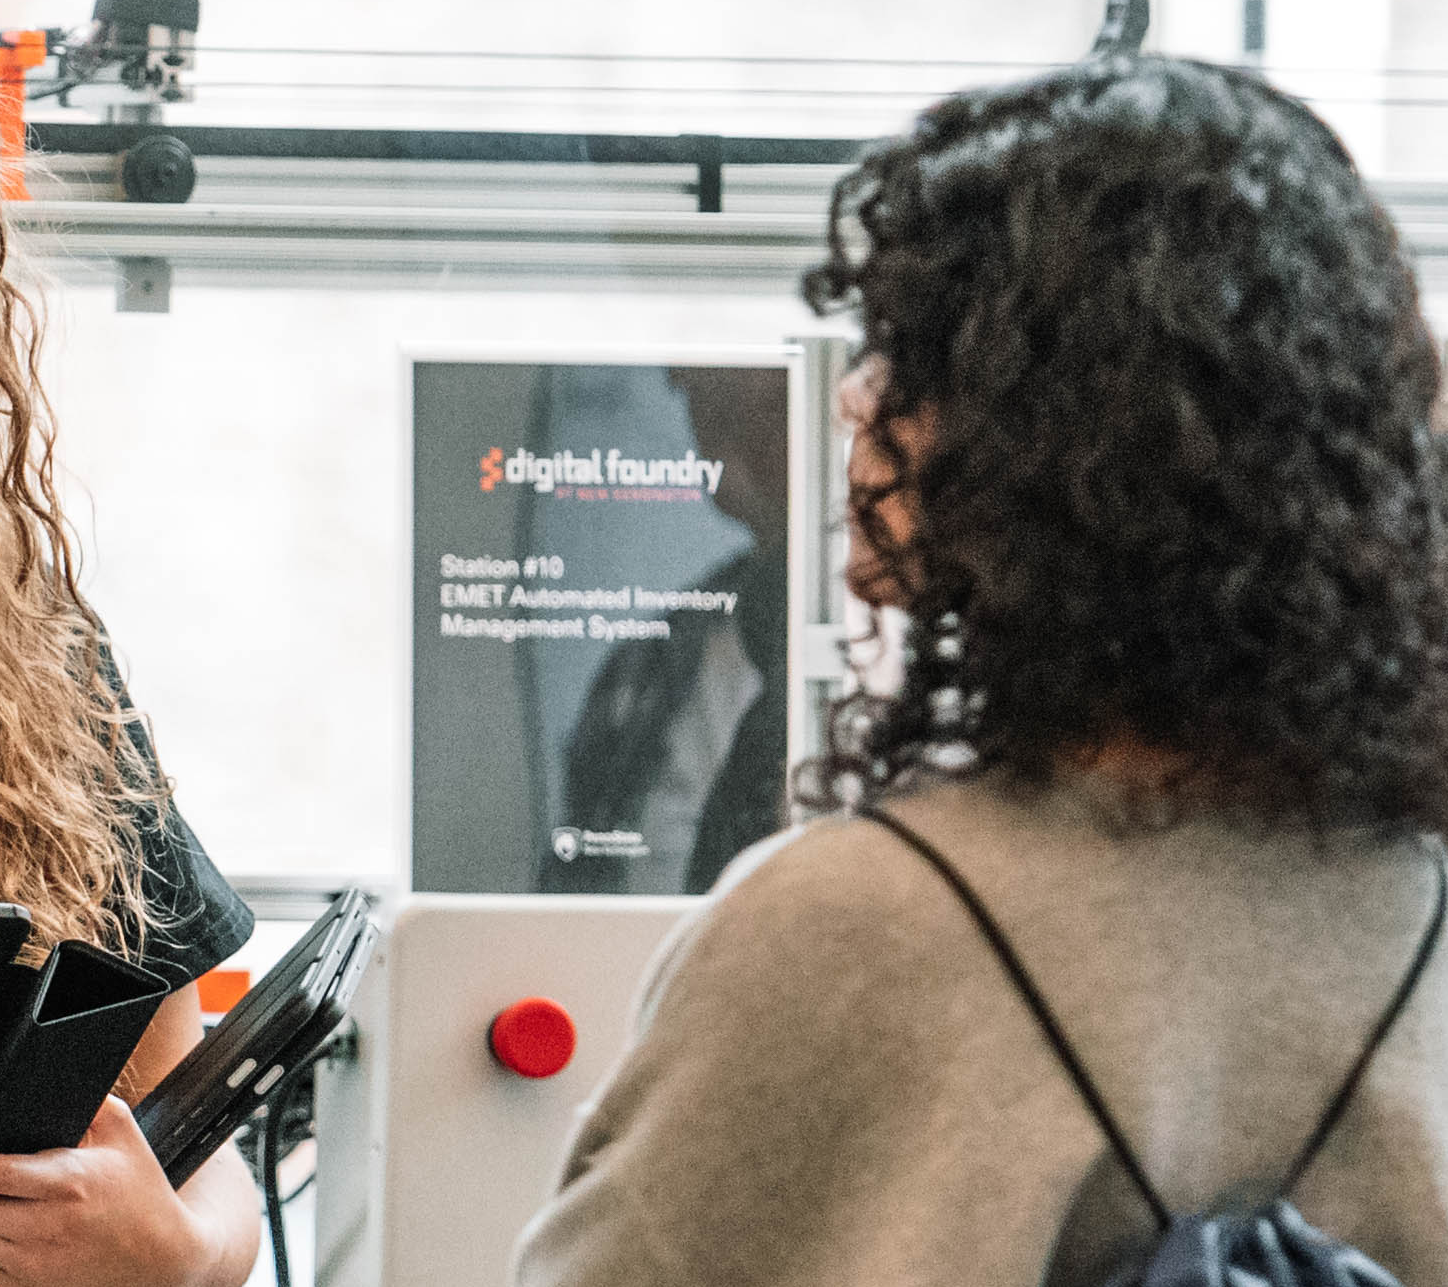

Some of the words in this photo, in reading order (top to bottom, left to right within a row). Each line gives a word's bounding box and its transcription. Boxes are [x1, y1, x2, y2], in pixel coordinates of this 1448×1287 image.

[505, 447, 604, 493] digital
[606, 448, 724, 495] foundry
[440, 553, 519, 579] Station
[522, 555, 564, 579] #10
[440, 583, 506, 608] EMET
[509, 585, 631, 609] Automated
[634, 587, 738, 614] Inventory
[440, 614, 585, 643] Management
[588, 616, 670, 642] System
